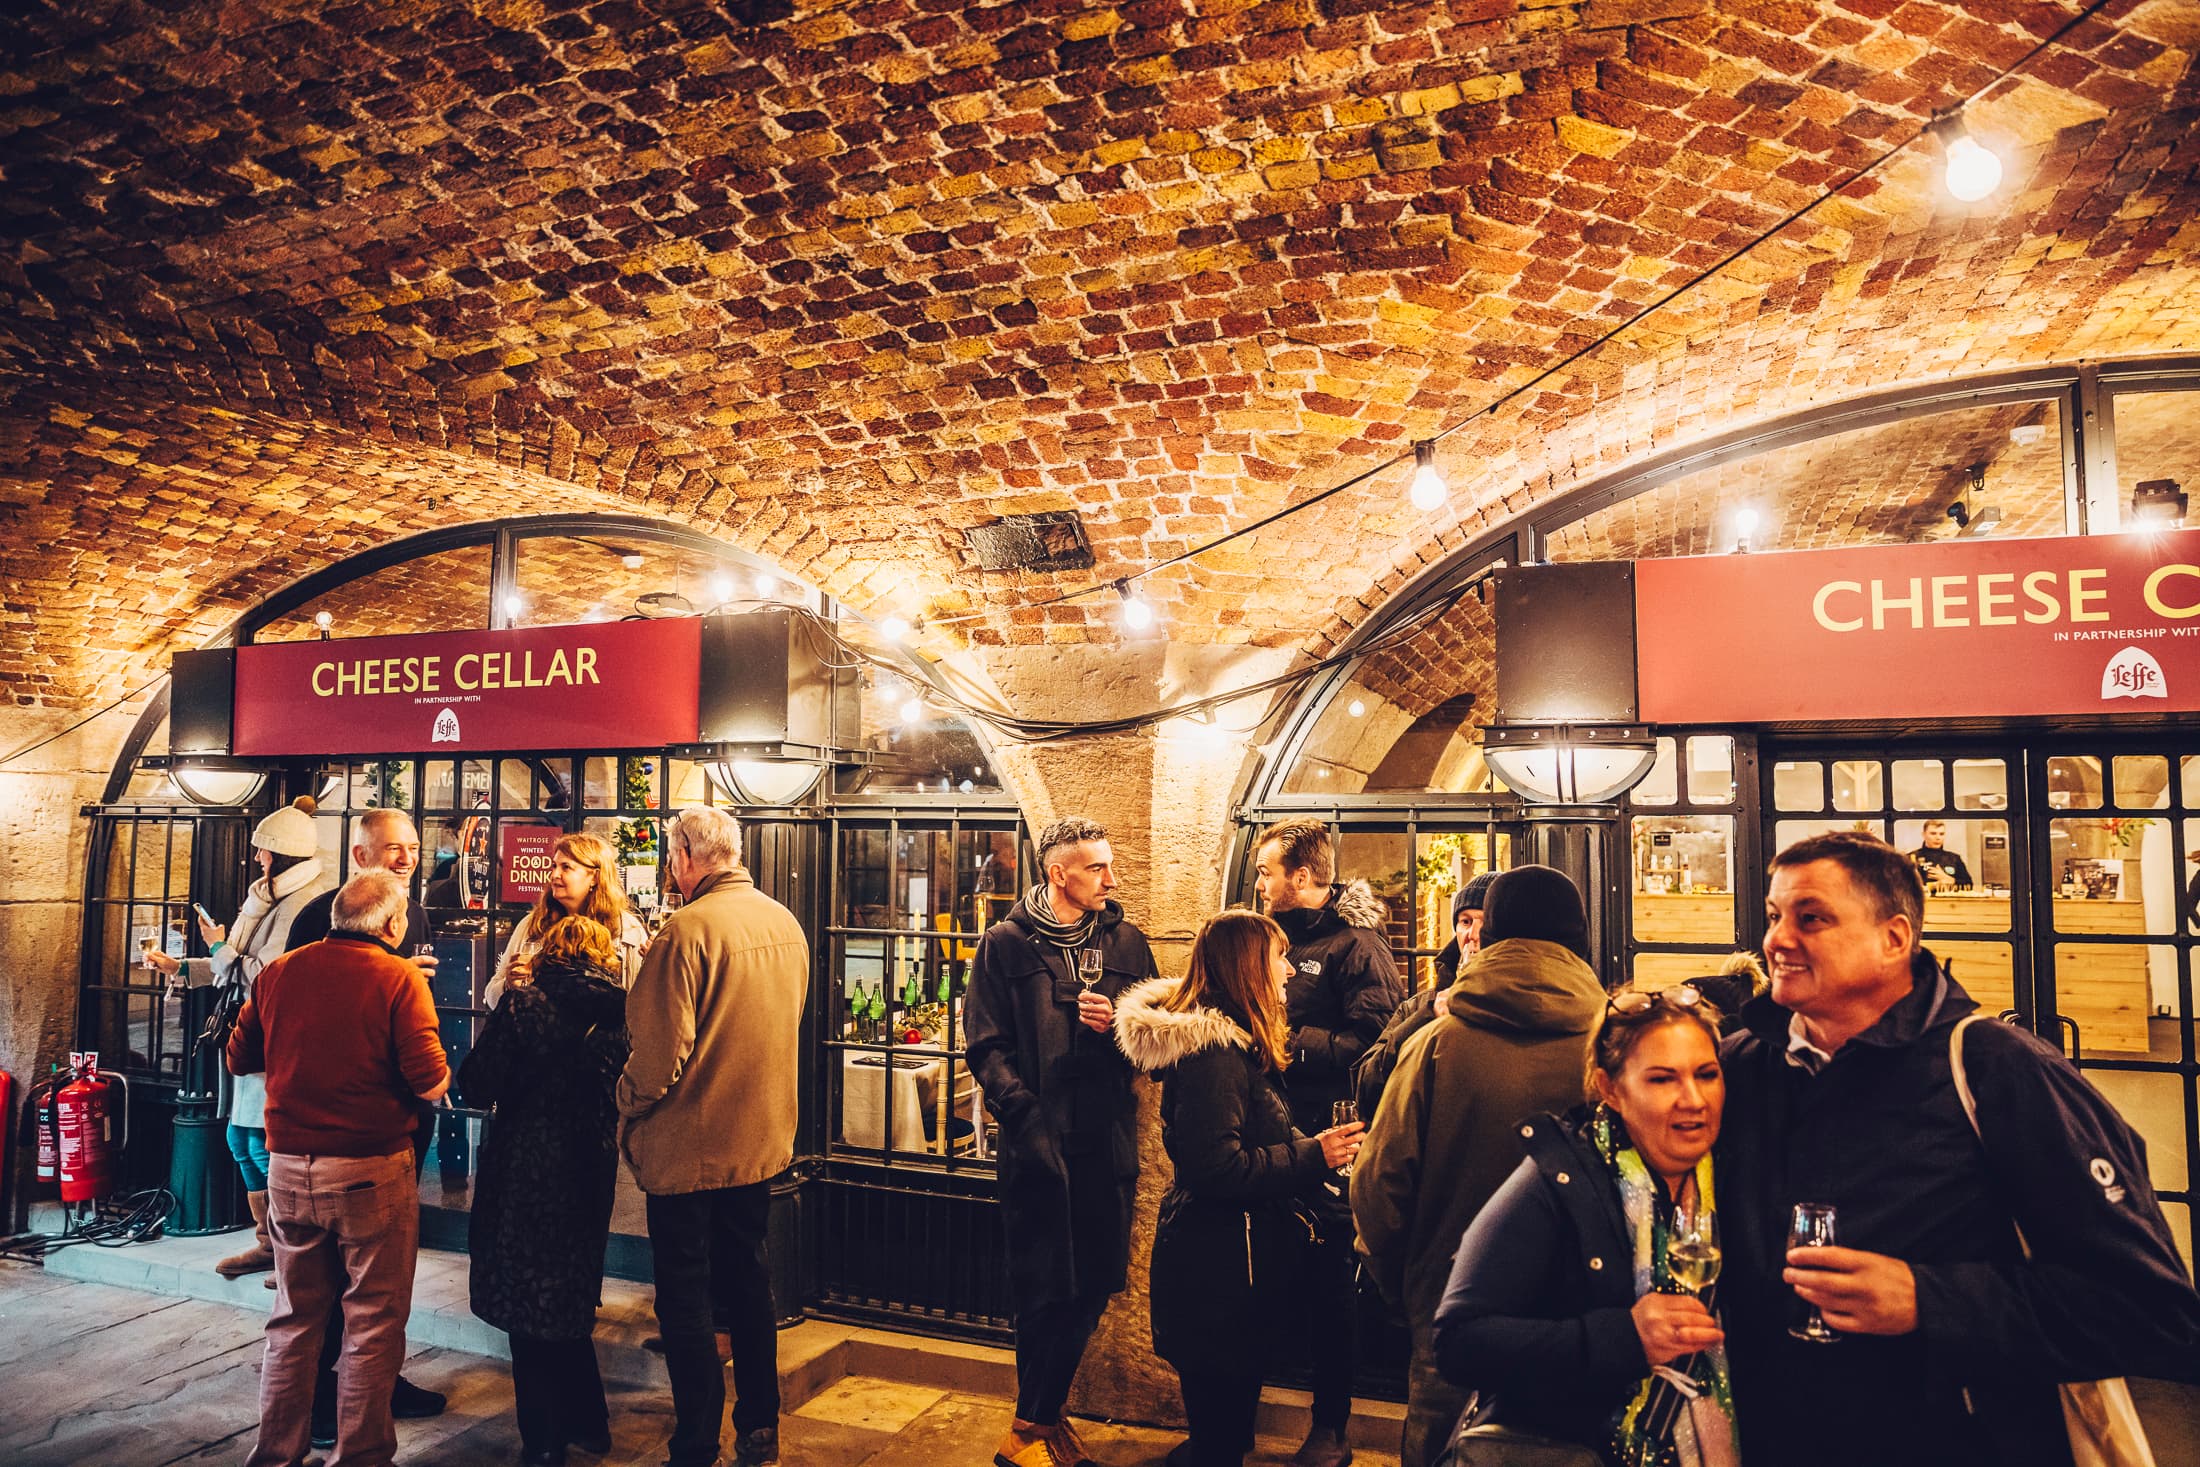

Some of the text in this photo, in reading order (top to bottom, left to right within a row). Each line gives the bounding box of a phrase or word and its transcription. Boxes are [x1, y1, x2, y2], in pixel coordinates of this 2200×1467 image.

[1811, 568, 2111, 632] CHEESE
[2053, 631, 2069, 641] IN
[2073, 628, 2167, 641] PARTNERSHIP
[311, 647, 601, 697] CHEESE CELLAR
[2110, 662, 2157, 691] Leffe
[414, 694, 481, 705] IN PARTNERSHIP WITH
[437, 718, 457, 738] Leffe
[512, 855, 552, 869] FOOD
[510, 870, 552, 884] DRINK
